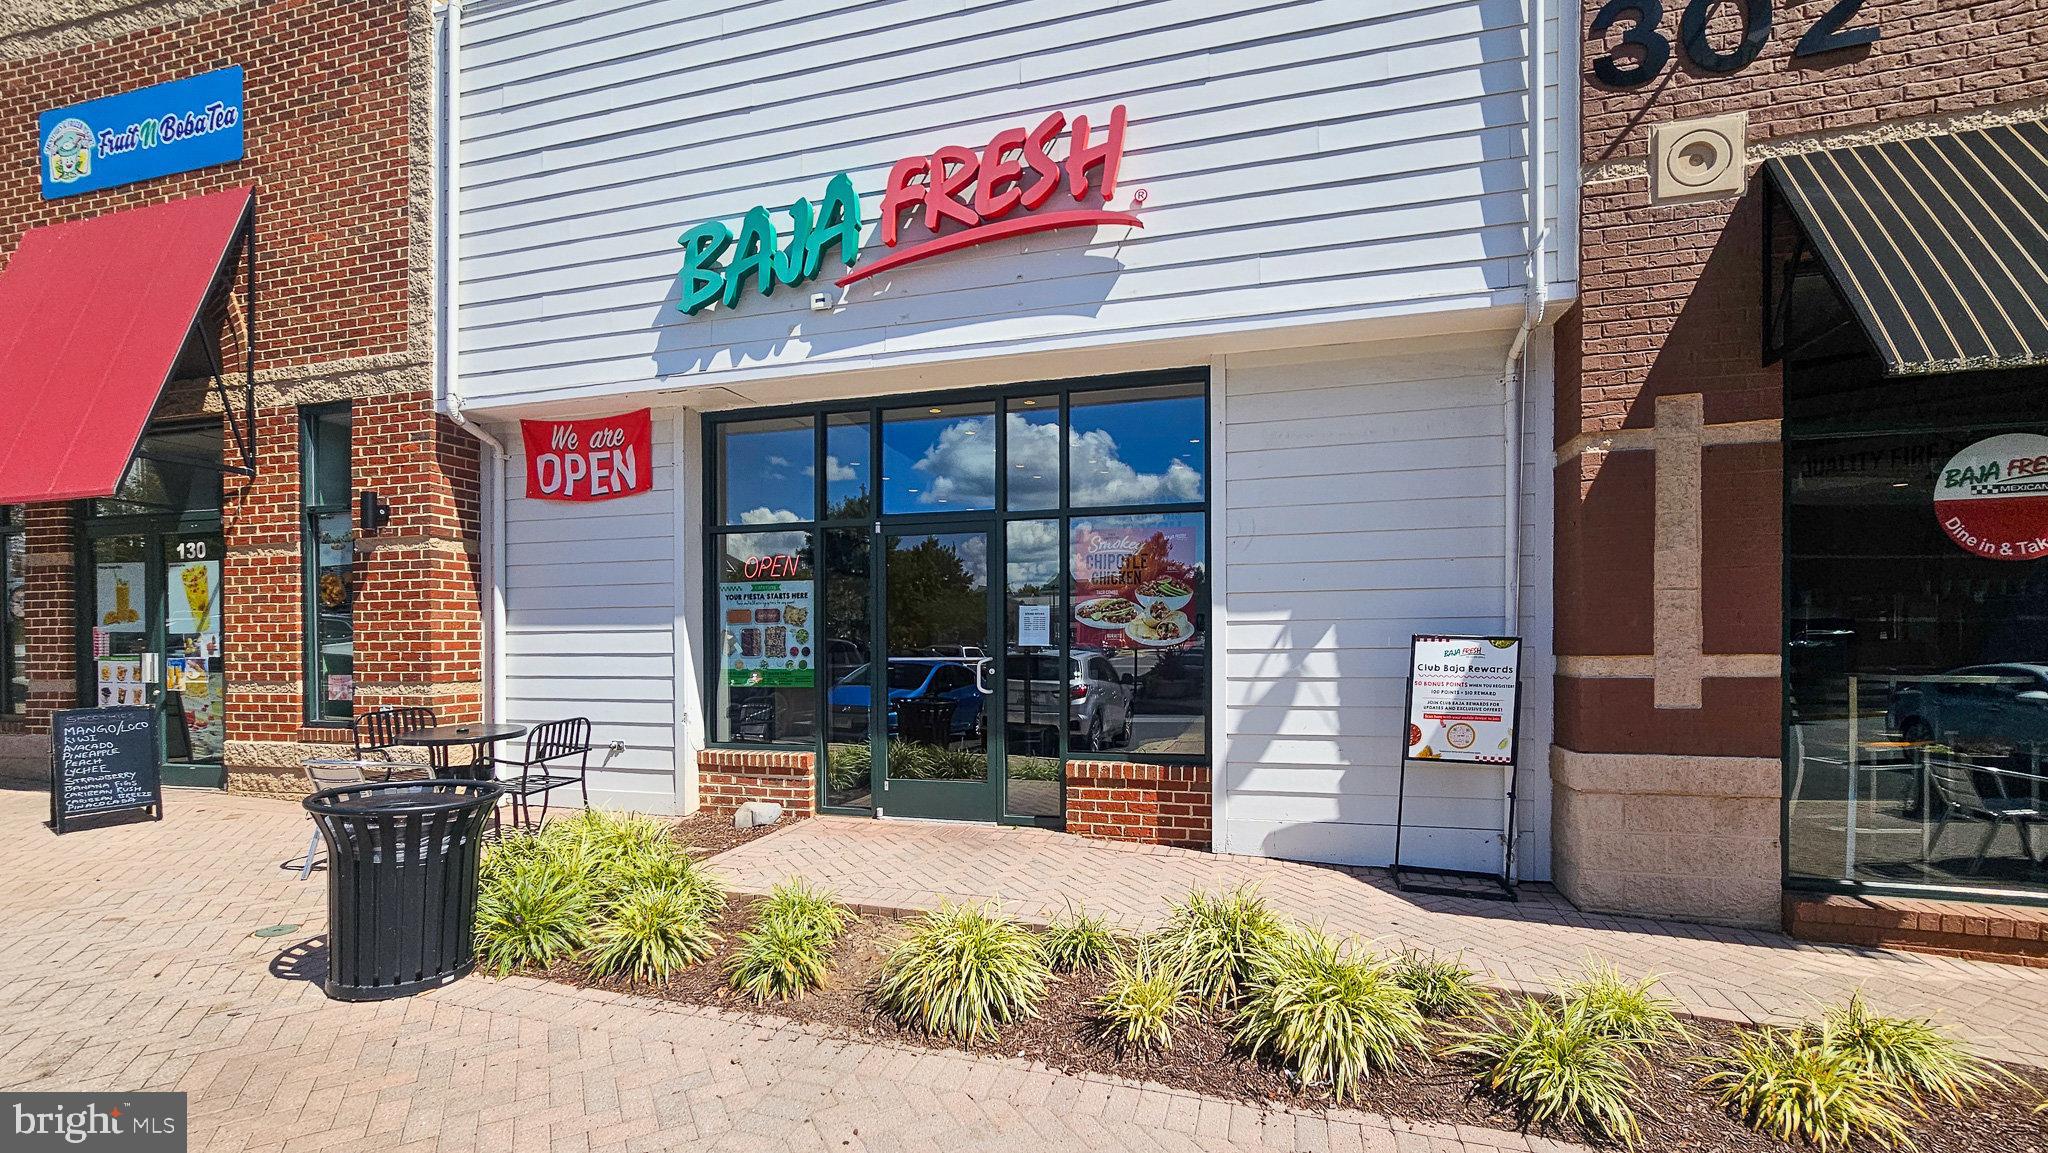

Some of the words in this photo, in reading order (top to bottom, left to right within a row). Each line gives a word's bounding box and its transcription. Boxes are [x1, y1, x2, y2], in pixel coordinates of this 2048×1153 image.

[98, 125, 139, 158] Fruit
[141, 118, 158, 147] N
[675, 170, 862, 317] BAJA
[880, 104, 1128, 247] FRESH
[551, 424, 579, 450] We
[589, 427, 625, 449] are
[536, 444, 637, 496] OPEN
[1944, 460, 2000, 488] BAJA
[2007, 455, 2048, 477] FRE
[1945, 516, 1977, 546] Dine
[1978, 539, 1996, 553] in
[2000, 542, 2013, 555] &
[177, 541, 206, 559] 130
[1088, 535, 1146, 555] Smokey
[744, 555, 800, 579] OPEN
[1086, 553, 1148, 570] CHIPOTLE
[1091, 571, 1142, 585] CHICKEN
[1444, 648, 1460, 658] BAJA
[1462, 647, 1482, 655] FRESH
[1417, 664, 1440, 672] Club
[1444, 664, 1465, 674] Baja
[1468, 665, 1514, 673] Rewards
[64, 720, 149, 736] MANGO/LOCO
[64, 735, 98, 744] KIWI
[64, 742, 114, 752] AVACADO
[63, 748, 120, 760] PINEAPPLE
[64, 764, 110, 776] LYCHEE
[65, 758, 102, 768] PEACH
[64, 772, 136, 785] STRAWBERRY
[64, 783, 110, 792] BANANA
